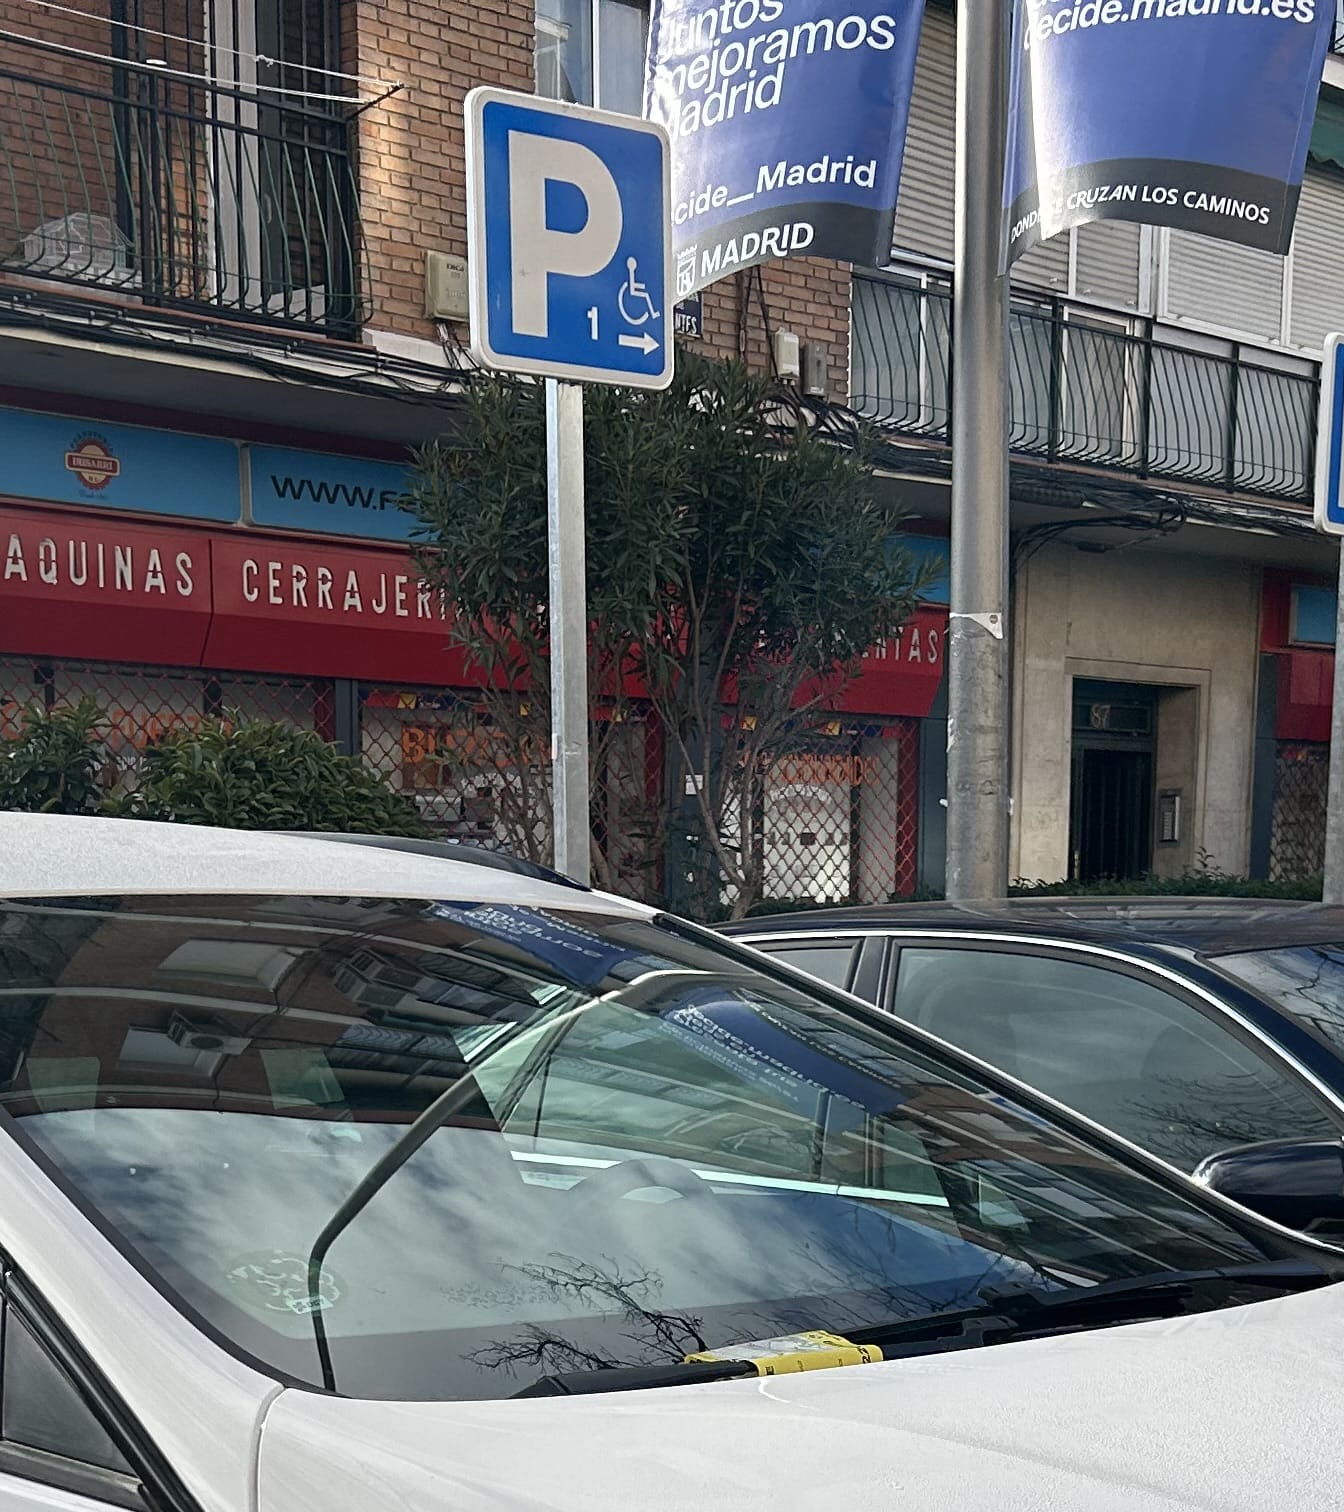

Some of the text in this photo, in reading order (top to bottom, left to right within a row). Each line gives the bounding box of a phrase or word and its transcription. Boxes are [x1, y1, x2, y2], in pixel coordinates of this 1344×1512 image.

[1067, 184, 1136, 210] CRUZAN
[1141, 186, 1178, 205] LOS
[1183, 191, 1271, 225] CAMINOS
[508, 129, 623, 339] P
[700, 222, 815, 278] MADRID
[587, 306, 599, 341] 1
[242, 559, 463, 621] CERRAJERI
